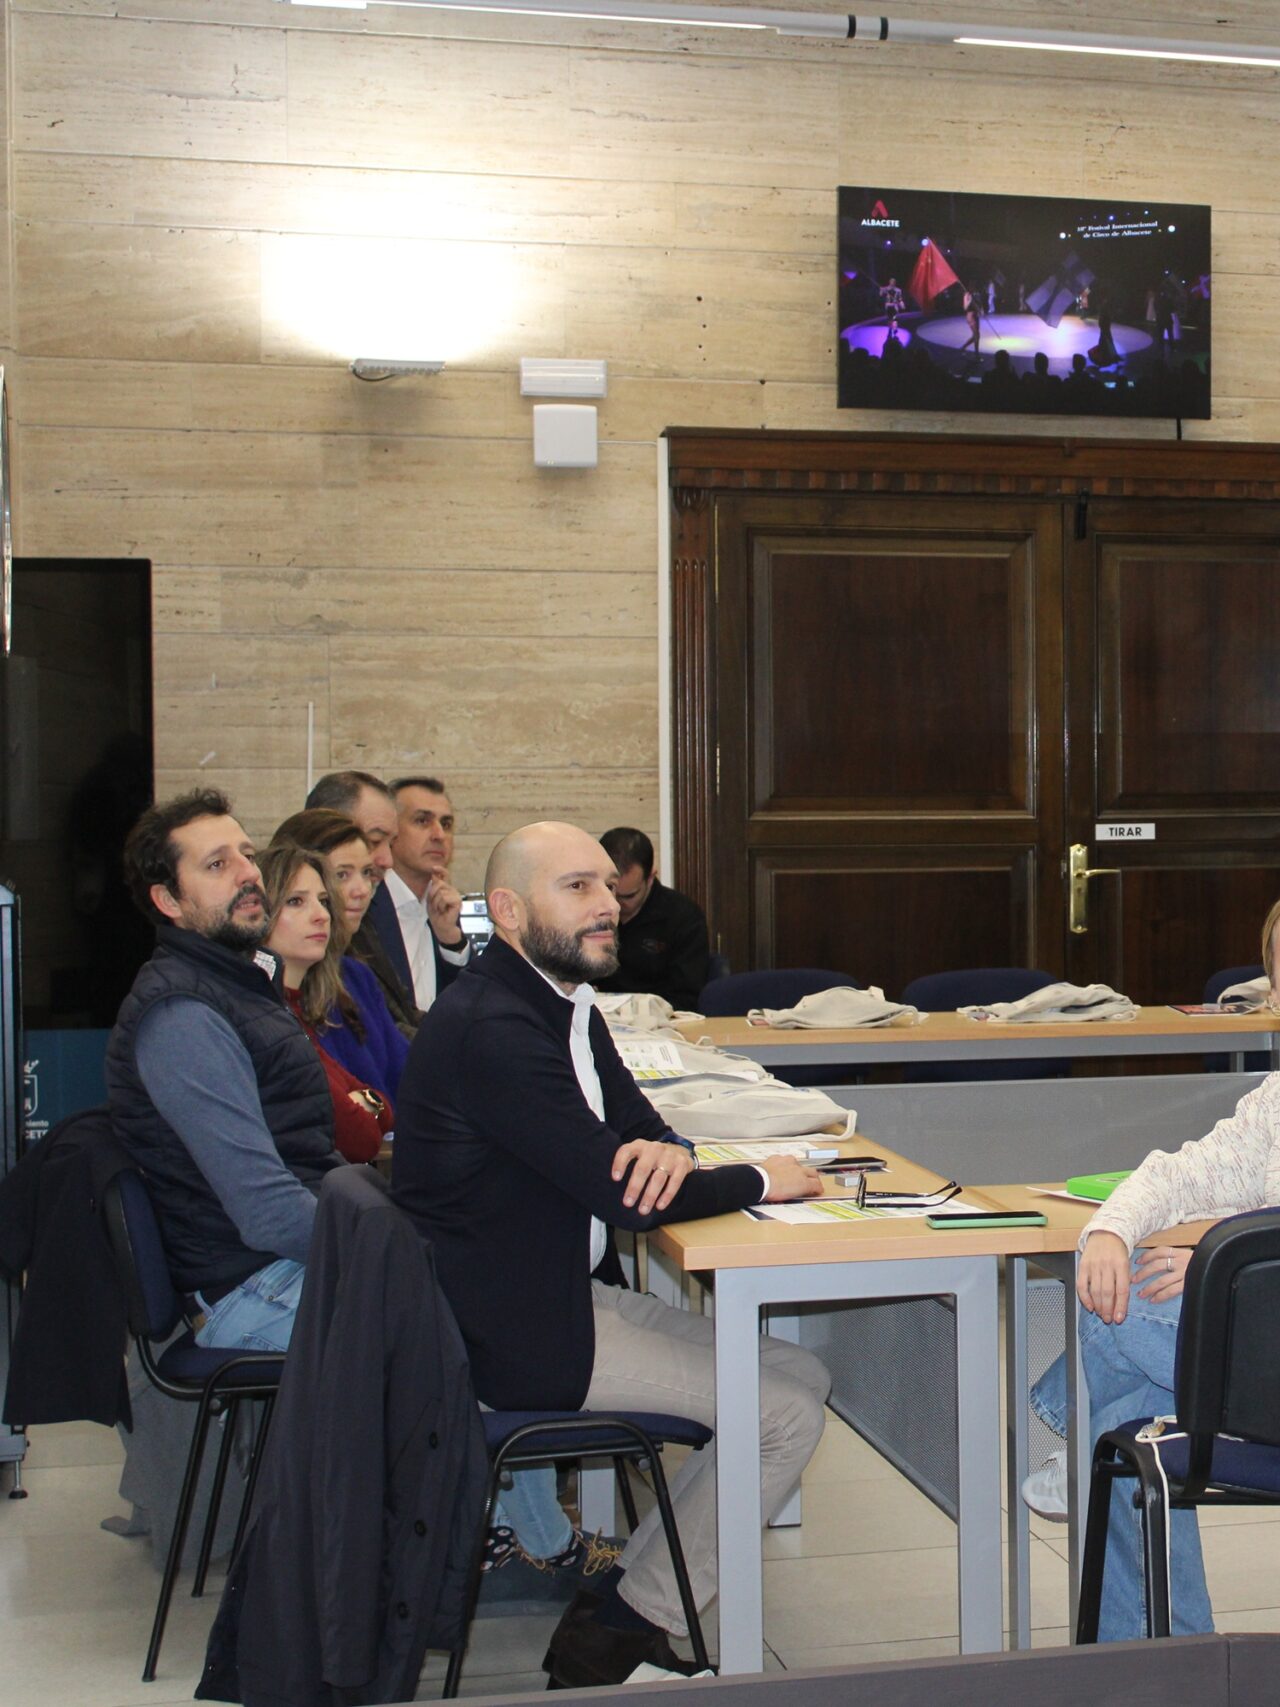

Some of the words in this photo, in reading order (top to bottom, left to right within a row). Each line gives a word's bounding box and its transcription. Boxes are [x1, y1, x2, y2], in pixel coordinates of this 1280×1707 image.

[861, 218, 900, 228] ALBACETE
[1112, 221, 1158, 230] Internacional
[1121, 229, 1152, 237] Albacete
[1109, 827, 1142, 837] TIRAR
